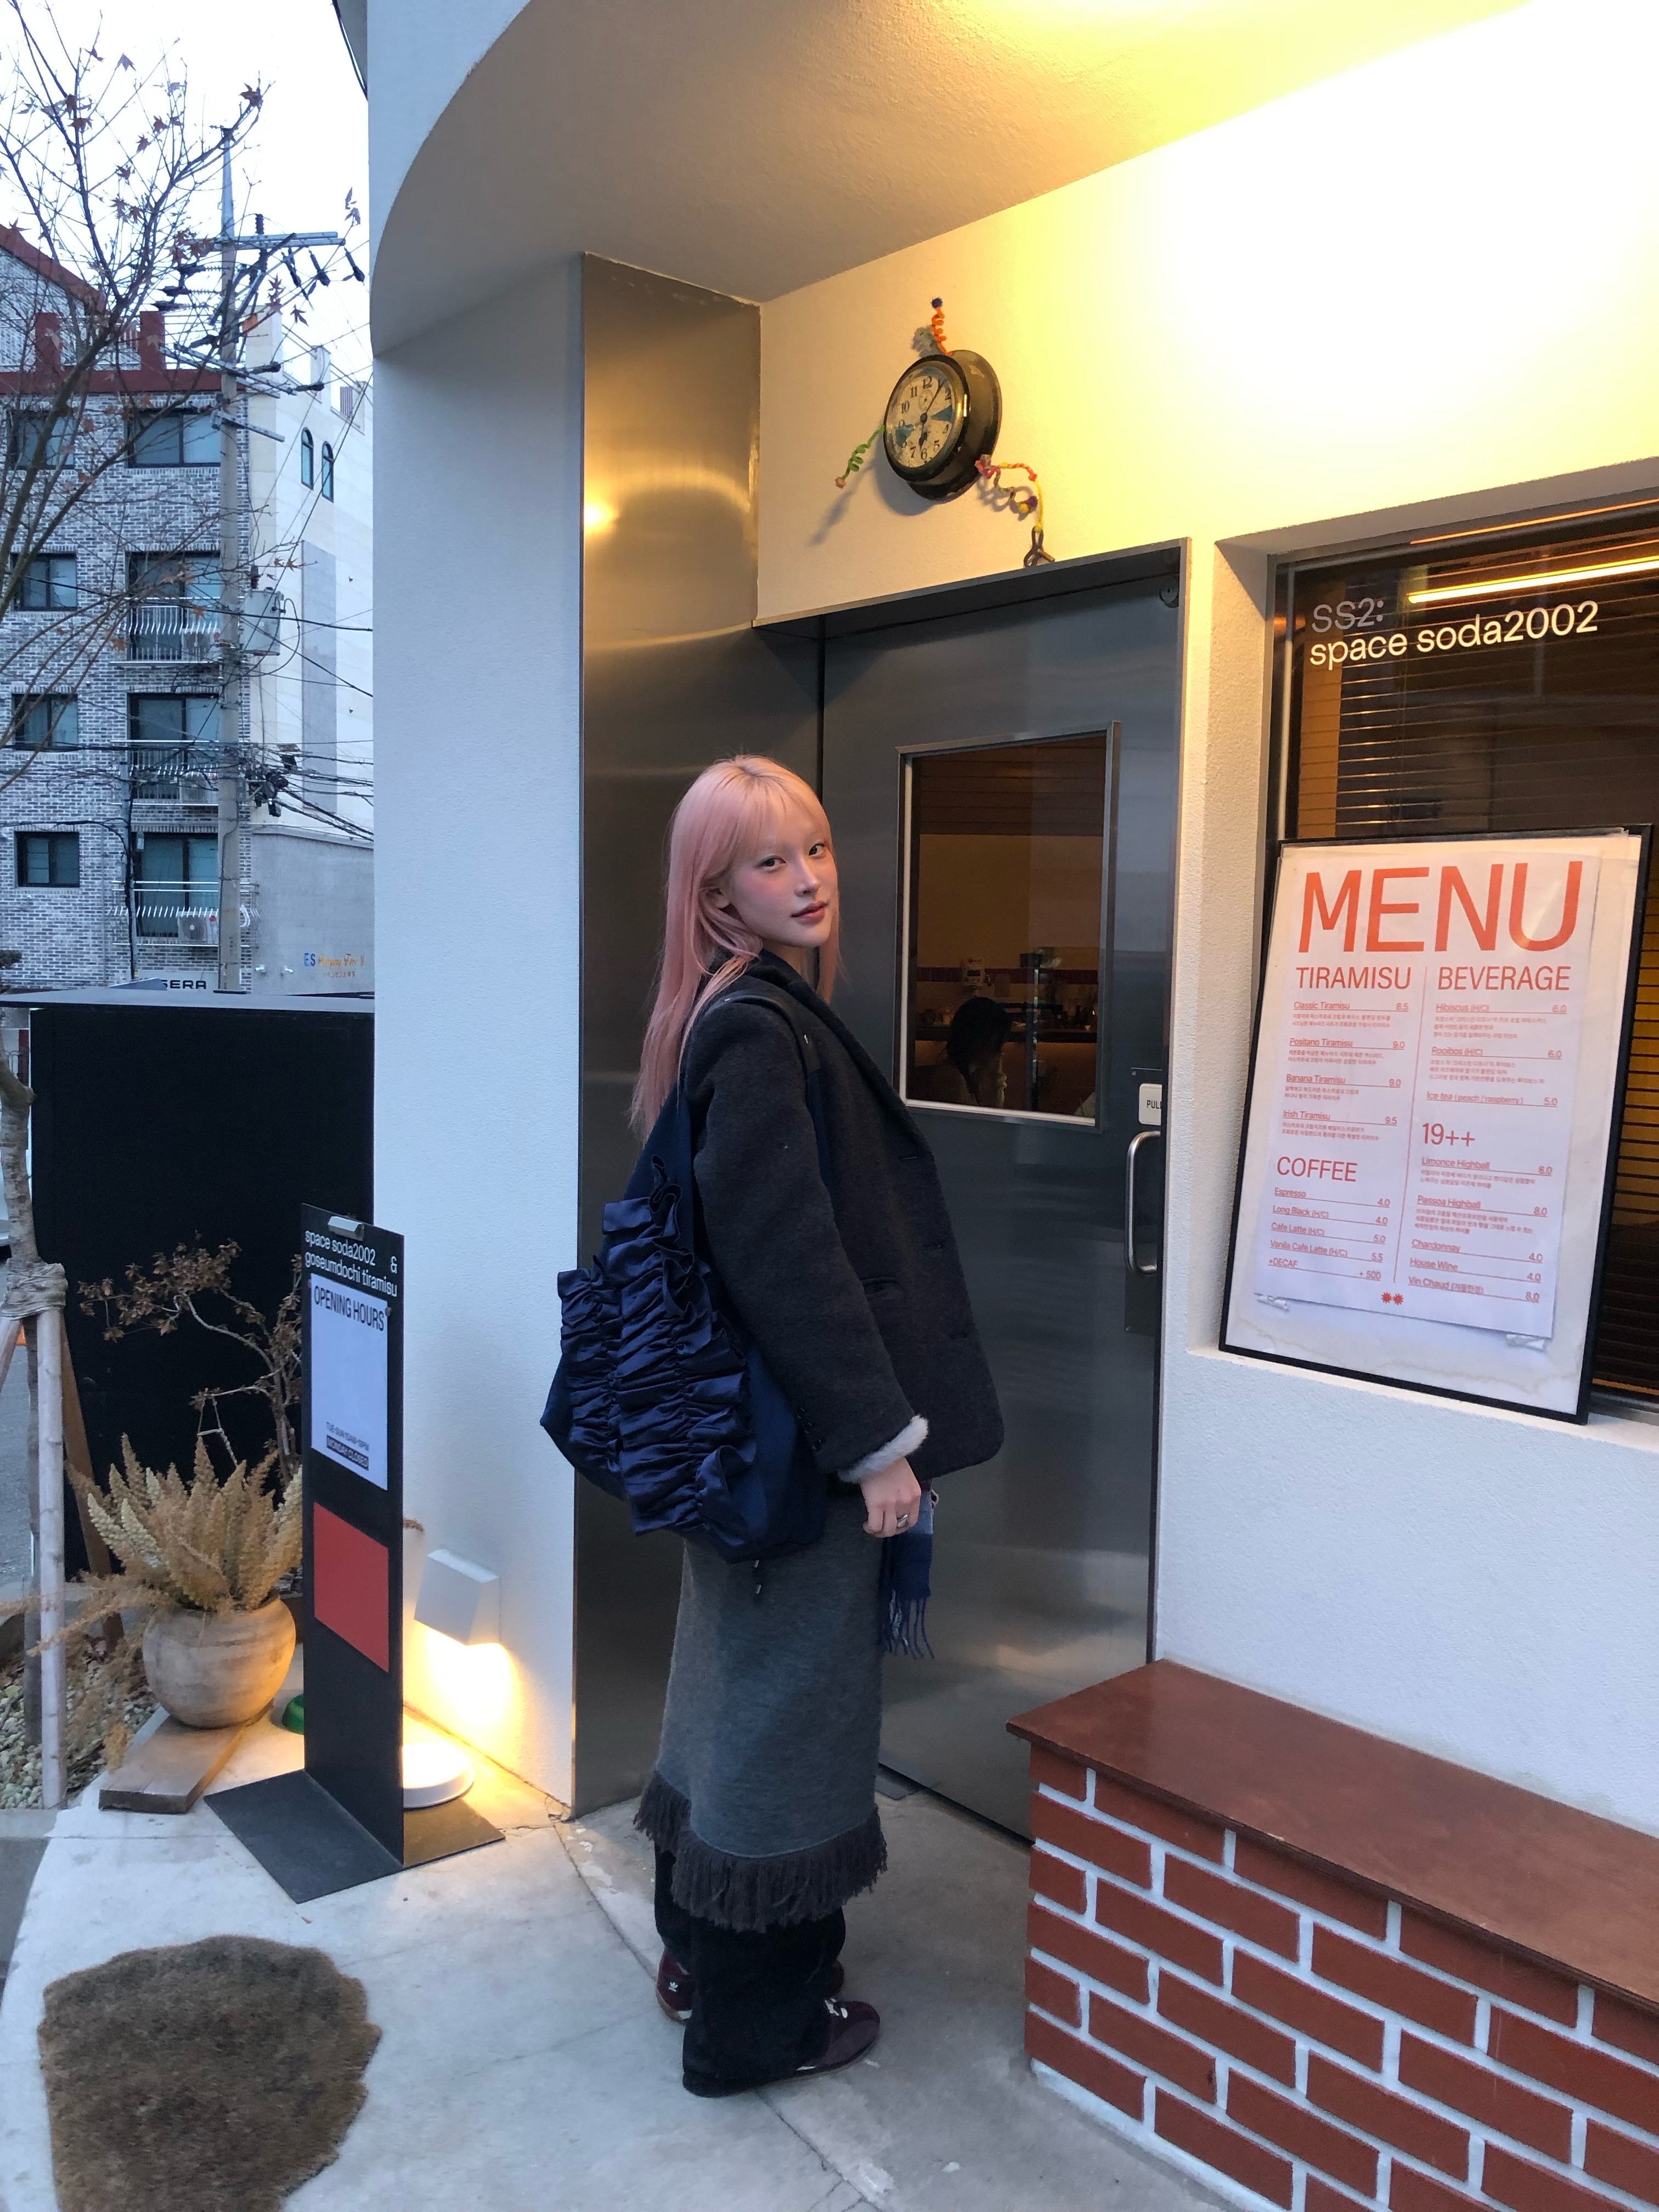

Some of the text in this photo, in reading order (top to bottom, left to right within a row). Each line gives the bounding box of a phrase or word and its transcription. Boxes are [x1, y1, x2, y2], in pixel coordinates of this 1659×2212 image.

[910, 386, 918, 398] 11
[922, 376, 932, 389] 12
[901, 400, 910, 414] 10
[942, 424, 949, 434] 4
[910, 446, 916, 459] 7
[921, 448, 928, 460] 6
[933, 439, 940, 452] 5
[1312, 597, 1384, 633] SS2:
[1310, 600, 1599, 670] space soda2002
[1299, 861, 1583, 952] MENU
[304, 953, 315, 967] ES
[1296, 967, 1412, 989] TIRAMISU
[1438, 966, 1571, 990] BEVERAGE
[1321, 1001, 1350, 1009] Tiramisu
[1552, 1005, 1567, 1013] 6.0
[1322, 1039, 1353, 1047] Tiramisu
[1432, 1046, 1463, 1055] Rooibos
[1548, 1050, 1562, 1058] 6.0
[1286, 1074, 1401, 1087] Banana Tiramisu 9.0
[1427, 1091, 1438, 1099] Ice
[1544, 1097, 1558, 1105] 5.0
[1283, 1110, 1397, 1125] Irish Tiramisu 9.5
[1422, 1122, 1475, 1147] 19++
[1277, 1156, 1357, 1182] COFFEE
[1421, 1156, 1553, 1175] Limonce Highball 8.0
[1274, 1187, 1390, 1207] Espresso 4.0
[1418, 1195, 1548, 1216] Passoa Highball 8.0
[1273, 1205, 1388, 1225] Long Black (H/C) 4.0
[1271, 1222, 1386, 1243] Cafe Latte (H/C) 5.0
[306, 1231, 398, 1274] space soda2002 &
[1292, 1242, 1308, 1252] Cafe
[1310, 1245, 1328, 1254] Latte
[1329, 1248, 1348, 1257] (H/C)
[1372, 1252, 1384, 1262] 5.5
[1412, 1239, 1543, 1262] Chardonnay 4.0
[305, 1251, 397, 1297] goseumdochi tiramisu
[1269, 1257, 1298, 1268] +DECAF
[1366, 1271, 1381, 1280] 500
[1410, 1257, 1541, 1282] House Wine 4.0
[1409, 1276, 1421, 1285] Vin
[1423, 1278, 1449, 1289] Chaud
[1525, 1291, 1539, 1301] 8.0
[314, 1285, 384, 1331] OPENING HOURS
[327, 1437, 368, 1468] MONDAY CLOSED
